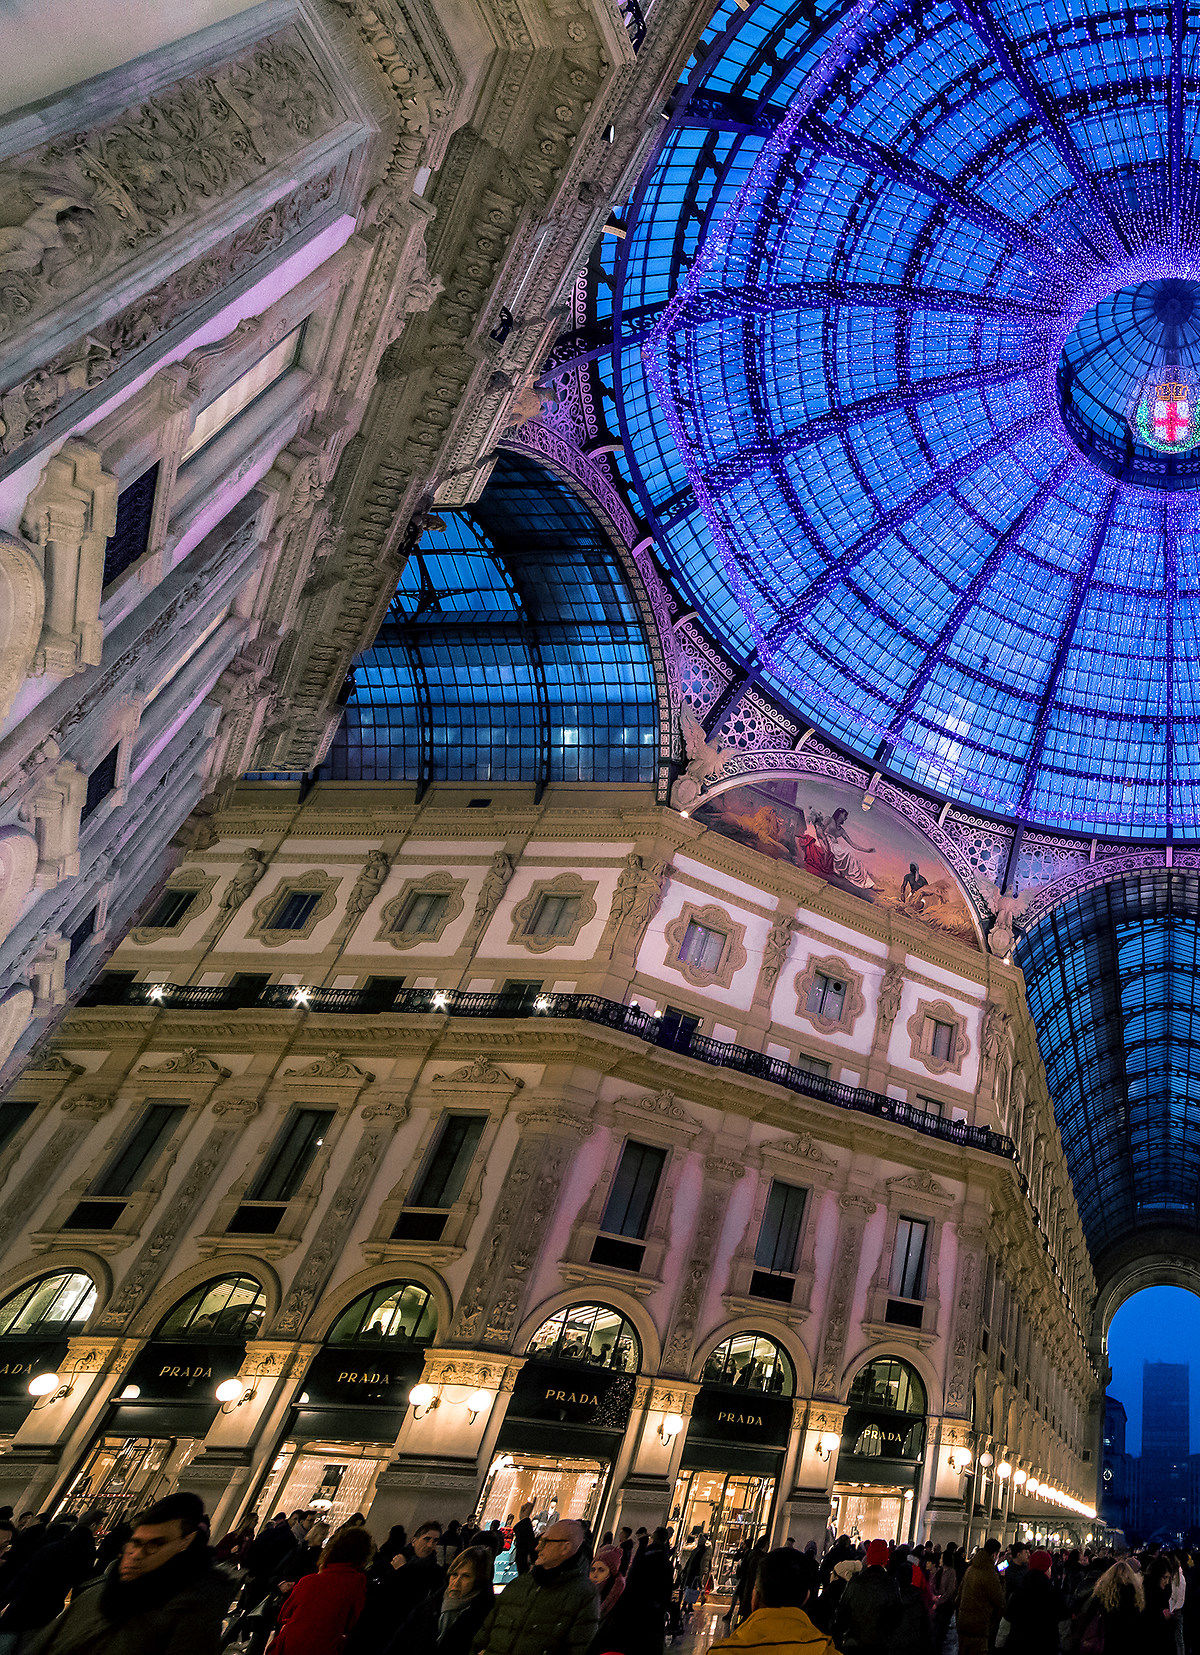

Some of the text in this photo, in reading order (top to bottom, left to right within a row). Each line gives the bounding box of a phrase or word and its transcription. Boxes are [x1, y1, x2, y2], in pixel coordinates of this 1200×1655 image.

[159, 1366, 212, 1377] PRADA
[337, 1372, 390, 1385] PRADA
[545, 1389, 599, 1406] PRADA
[718, 1411, 763, 1426] PRADA
[863, 1429, 902, 1442] PRADA
